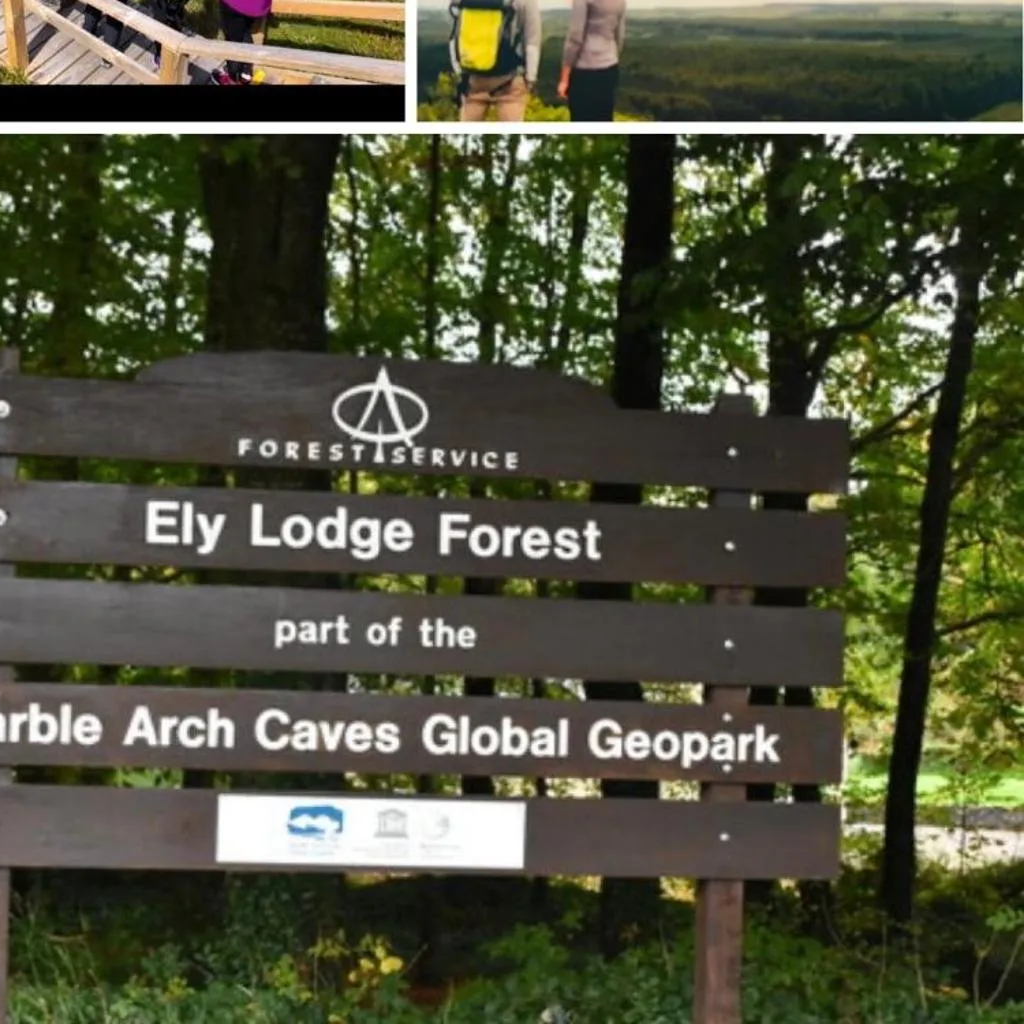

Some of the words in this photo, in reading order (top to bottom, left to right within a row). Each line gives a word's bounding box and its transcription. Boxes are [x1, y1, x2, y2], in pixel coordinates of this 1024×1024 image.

[237, 437, 366, 462] FOREST
[391, 446, 518, 470] SERVICE
[146, 500, 226, 555] Ely
[251, 503, 414, 560] Lodge
[439, 513, 601, 560] Forest
[274, 615, 349, 648] part
[366, 616, 402, 646] of
[419, 617, 477, 648] the
[123, 705, 235, 748] Arch
[254, 708, 400, 753] Caves
[422, 713, 569, 757] Global
[588, 719, 780, 766] Geopark
